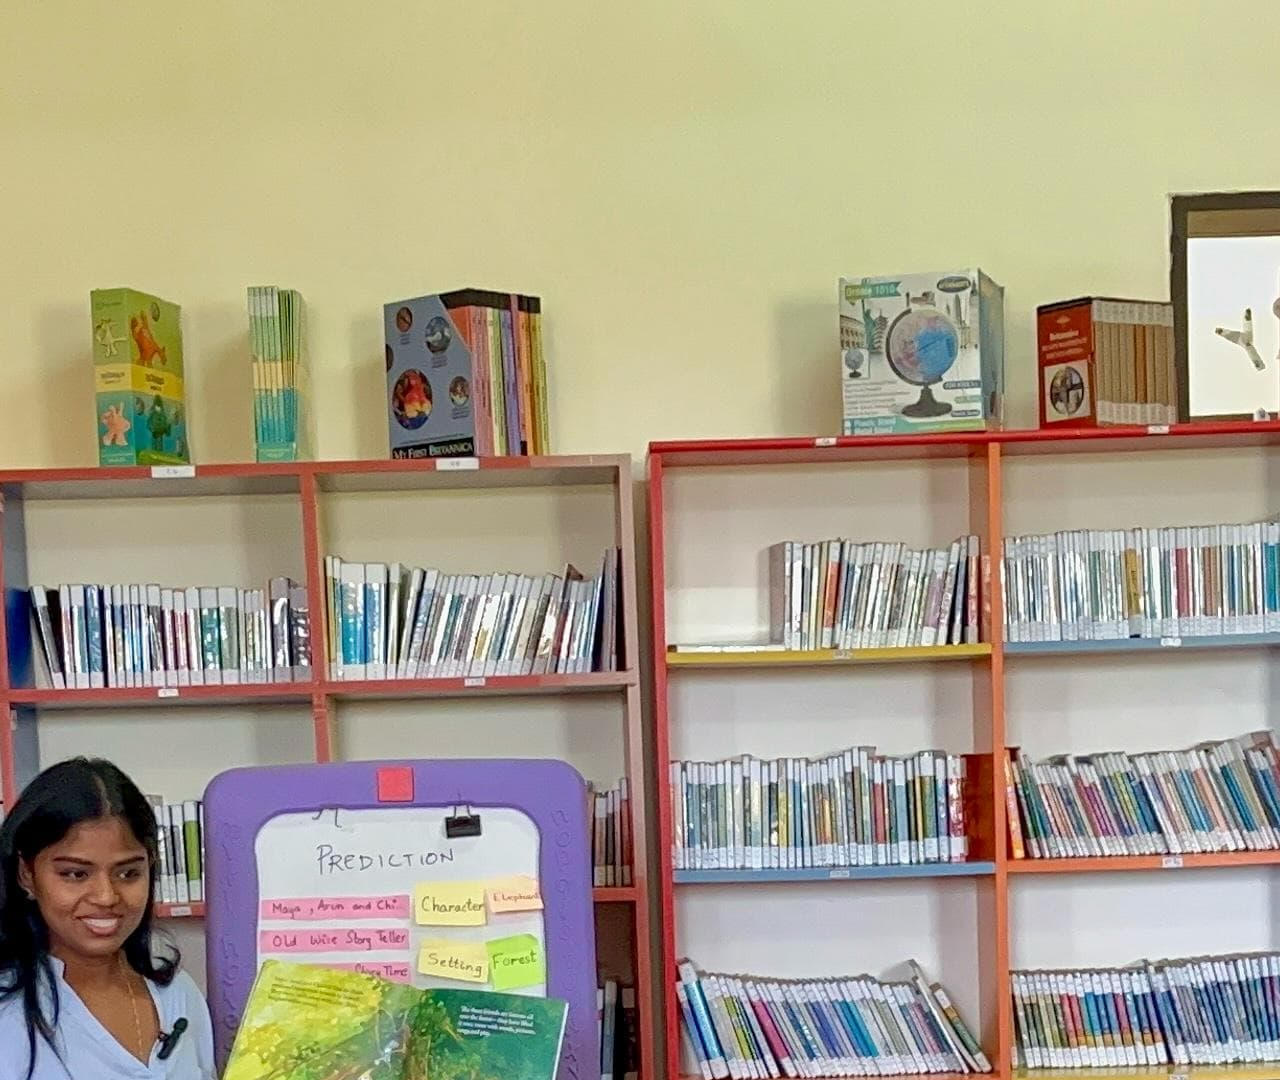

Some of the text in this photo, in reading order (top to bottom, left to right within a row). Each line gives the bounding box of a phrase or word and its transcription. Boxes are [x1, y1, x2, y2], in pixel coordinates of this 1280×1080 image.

[316, 844, 454, 875] PREDICTION
[352, 902, 371, 910] and
[421, 896, 485, 912] Character
[272, 935, 297, 947] Old
[375, 930, 406, 943] Teller
[428, 953, 482, 977] Setting
[491, 950, 536, 969] Forest
